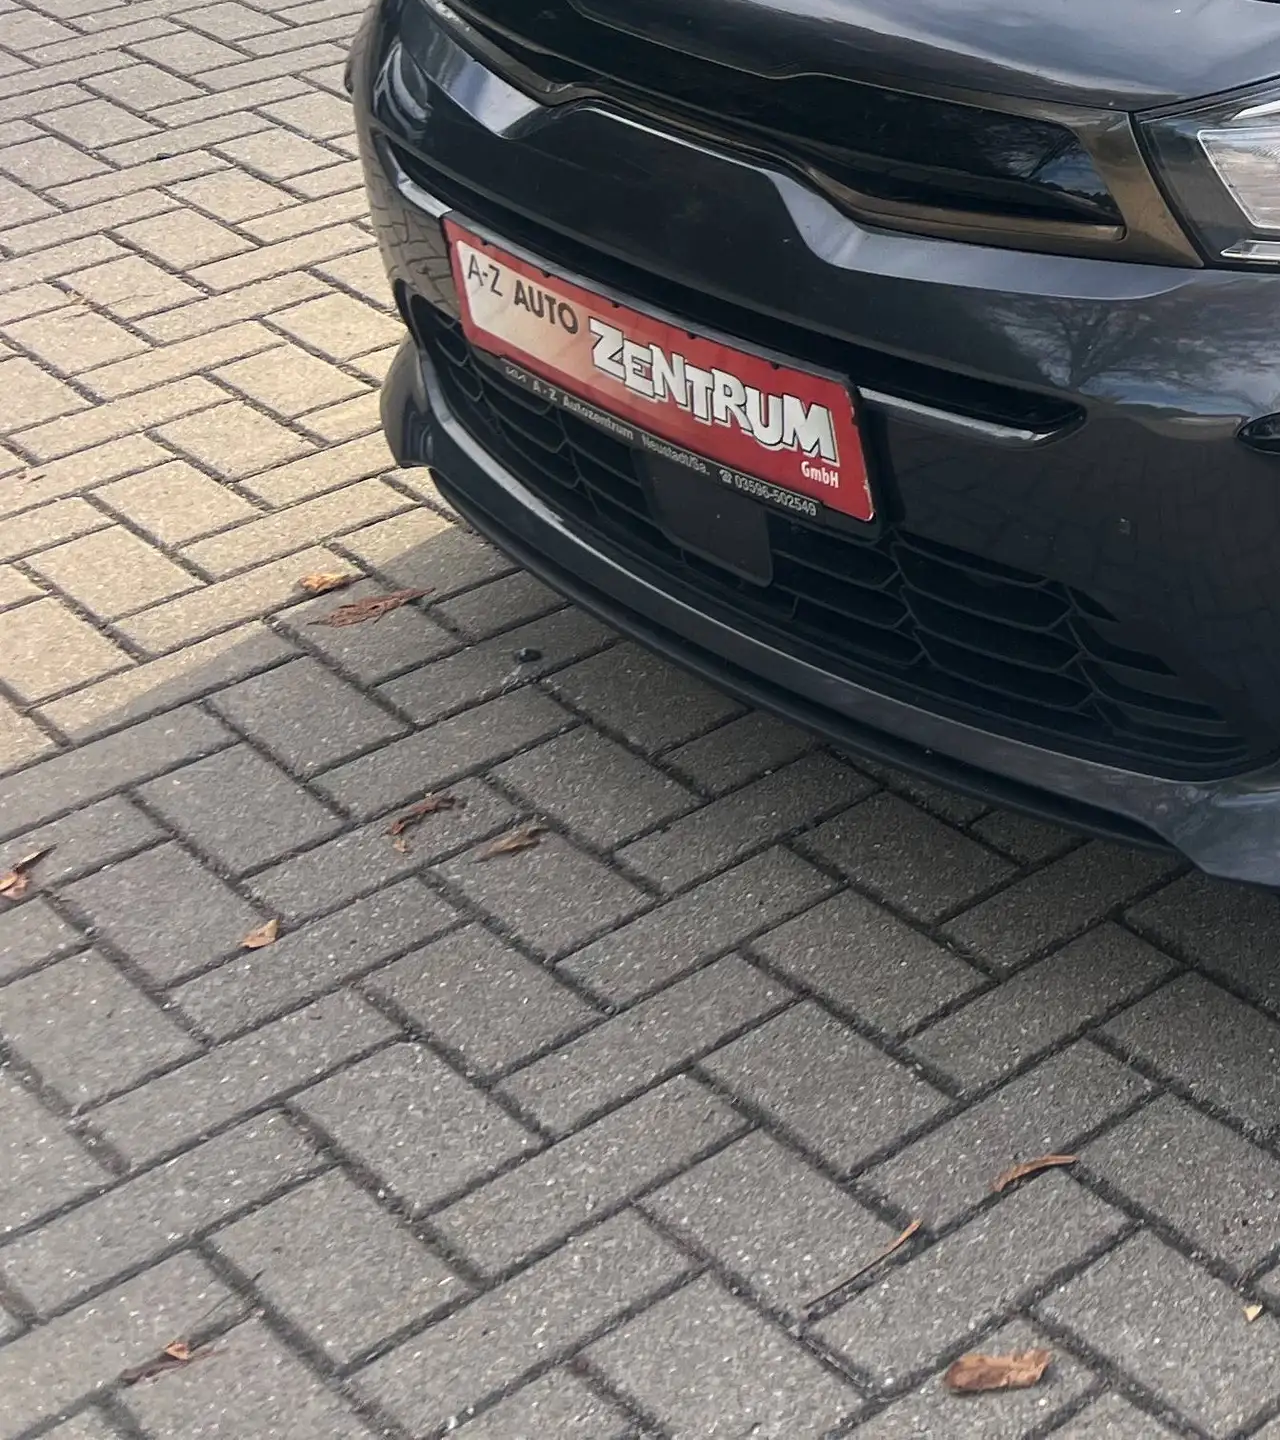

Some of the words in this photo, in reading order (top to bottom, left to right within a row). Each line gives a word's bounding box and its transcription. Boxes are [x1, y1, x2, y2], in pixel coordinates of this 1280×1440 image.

[468, 254, 503, 297] A-Z
[514, 279, 579, 335] AUTO
[563, 395, 634, 440] Autozentrum
[588, 316, 841, 467] ZENTRUM
[801, 461, 839, 488] GmbH
